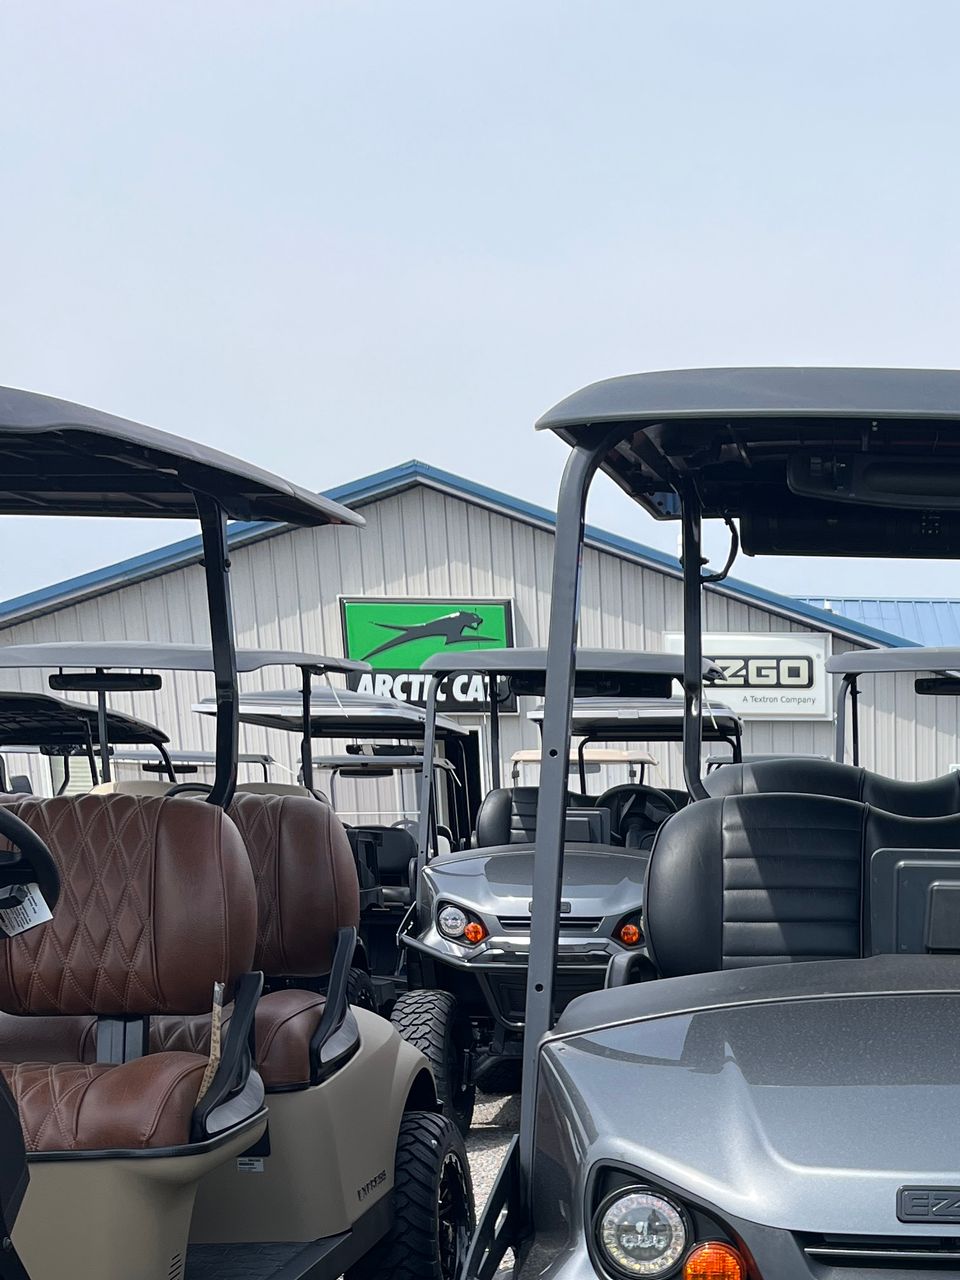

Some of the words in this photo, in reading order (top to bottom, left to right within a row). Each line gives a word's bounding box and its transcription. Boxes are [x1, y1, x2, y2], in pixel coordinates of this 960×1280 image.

[702, 659, 809, 685] ZGO
[356, 674, 448, 701] ARCTIC
[742, 695, 749, 703] A
[750, 695, 779, 703] Textron
[780, 695, 816, 705] Company
